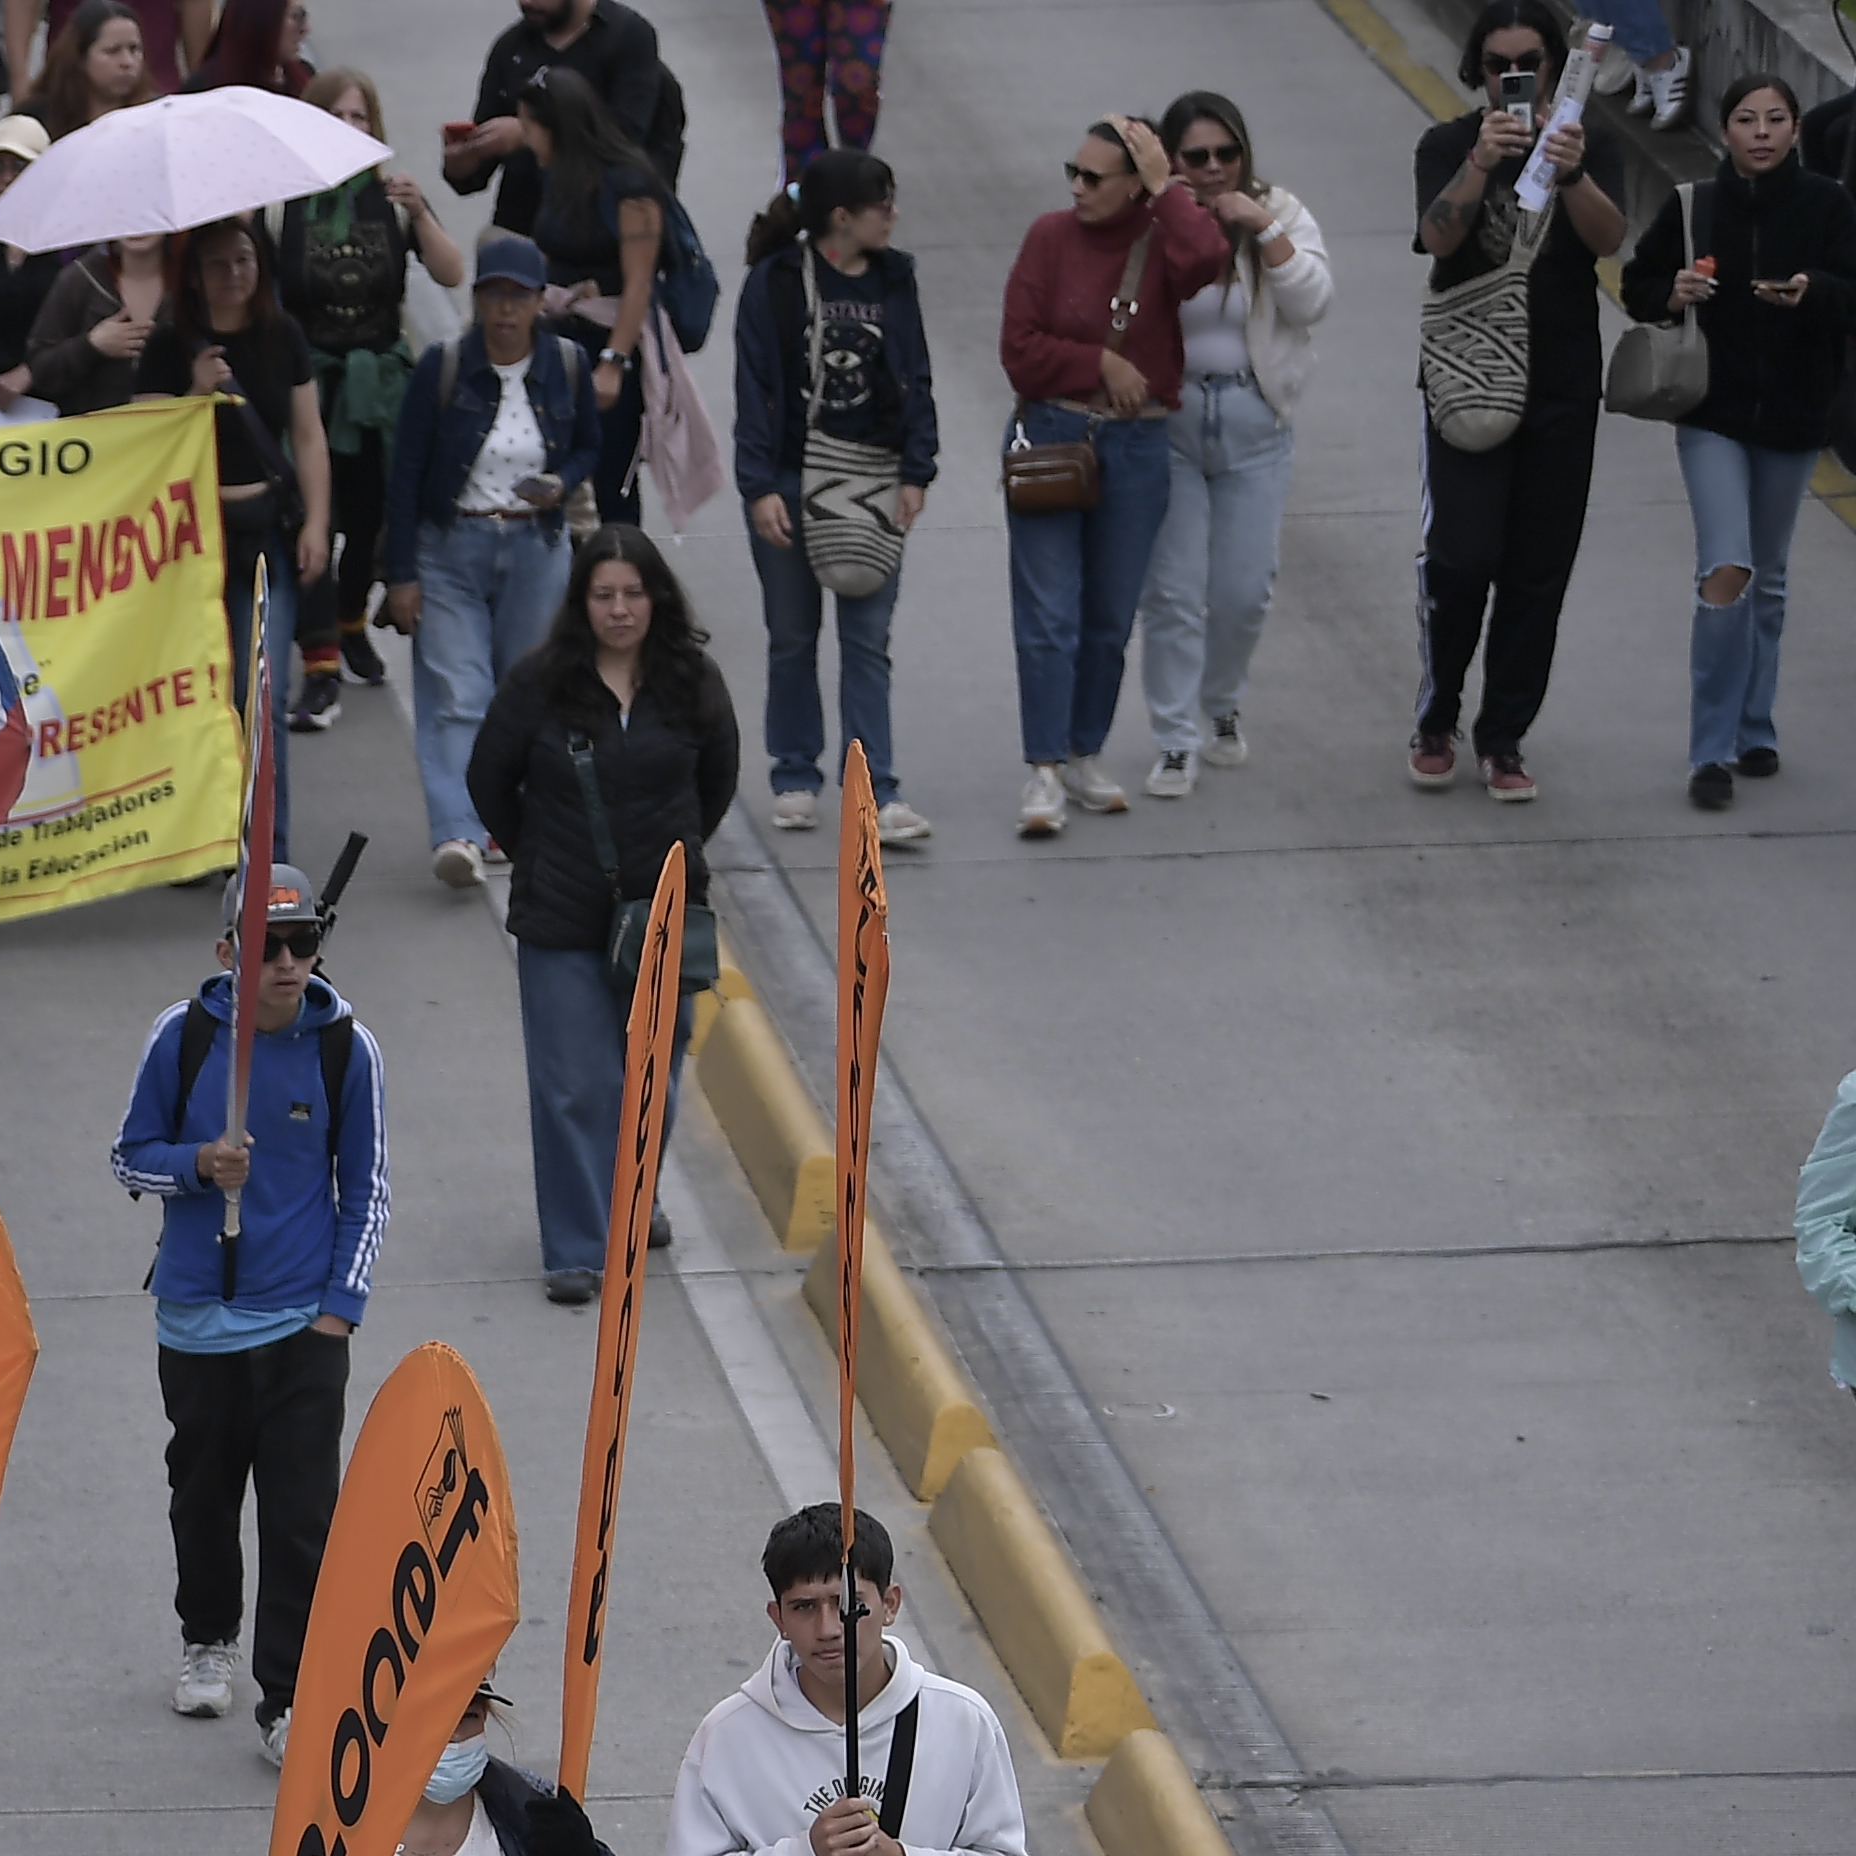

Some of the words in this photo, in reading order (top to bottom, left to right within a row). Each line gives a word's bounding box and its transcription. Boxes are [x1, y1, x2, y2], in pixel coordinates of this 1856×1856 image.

[39, 668, 196, 758] RESENTE
[207, 663, 219, 700] !
[0, 865, 19, 885] la
[803, 1785, 836, 1815] THE
